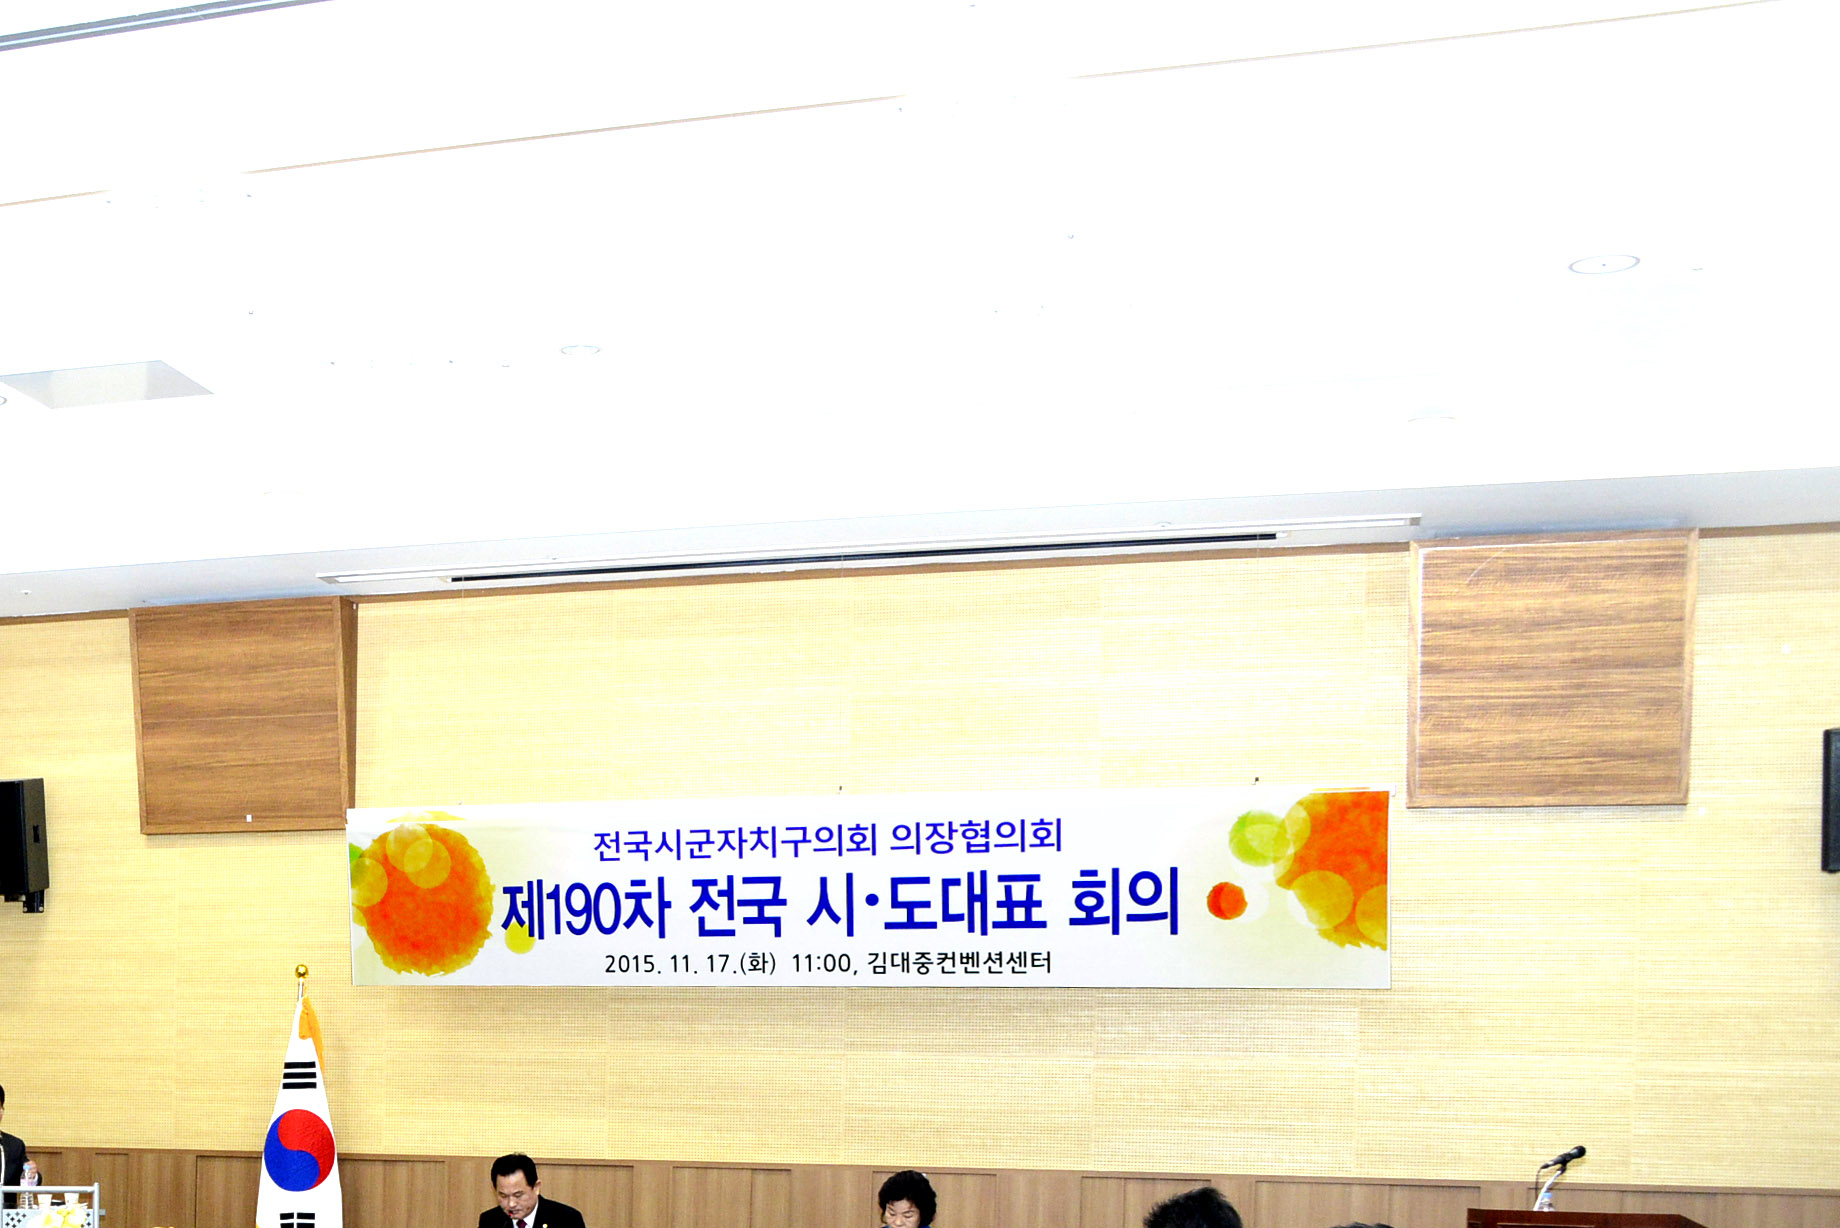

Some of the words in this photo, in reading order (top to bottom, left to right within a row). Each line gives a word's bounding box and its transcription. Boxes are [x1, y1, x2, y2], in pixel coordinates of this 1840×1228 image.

[593, 823, 878, 862] 전국시군자치구의회
[890, 817, 1063, 857] 의장협의회
[500, 875, 673, 941] 제190차
[688, 873, 789, 939] 전국
[1068, 866, 1179, 938] 회의
[604, 953, 662, 976] 2015.
[669, 953, 699, 976] 11.
[791, 952, 860, 977] 11:00,
[867, 950, 1053, 976] 김대중컨벤션센터
